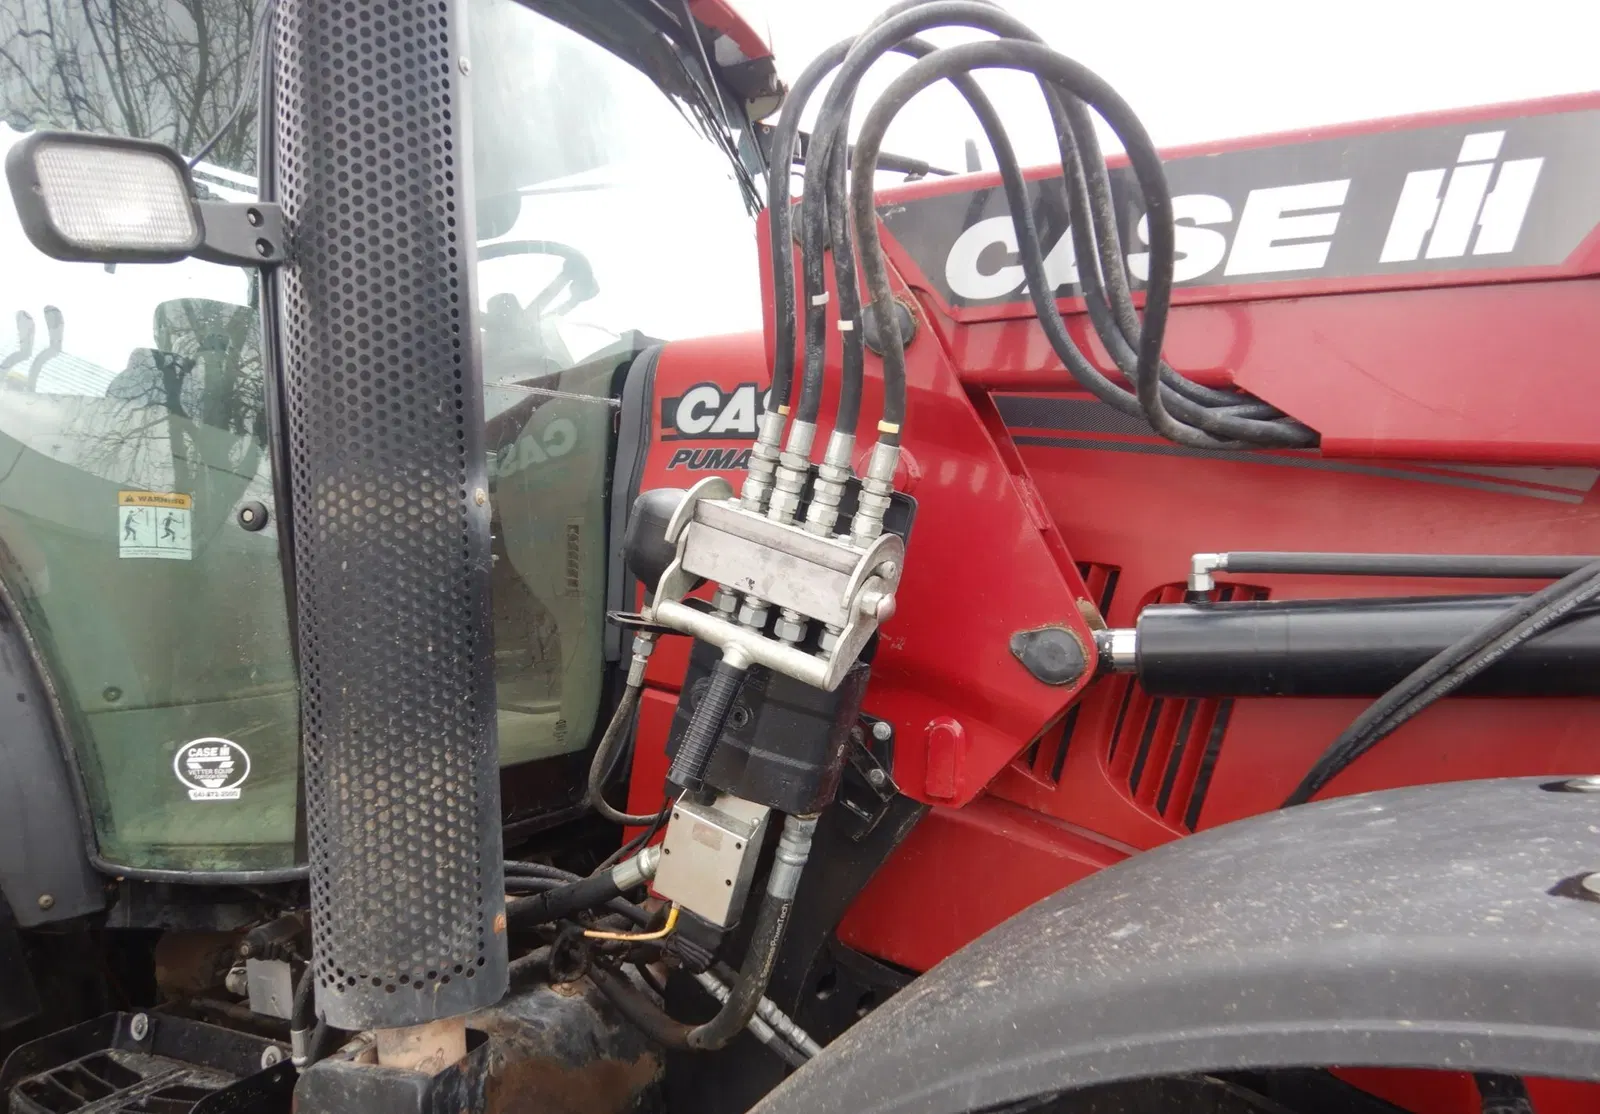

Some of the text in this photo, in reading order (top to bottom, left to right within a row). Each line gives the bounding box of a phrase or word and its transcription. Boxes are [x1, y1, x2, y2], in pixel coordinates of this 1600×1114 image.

[676, 386, 771, 434] CA
[667, 449, 753, 469] PUMA
[138, 496, 185, 505] WARNING
[1502, 637, 1520, 651] MAX
[188, 747, 218, 757] CASE
